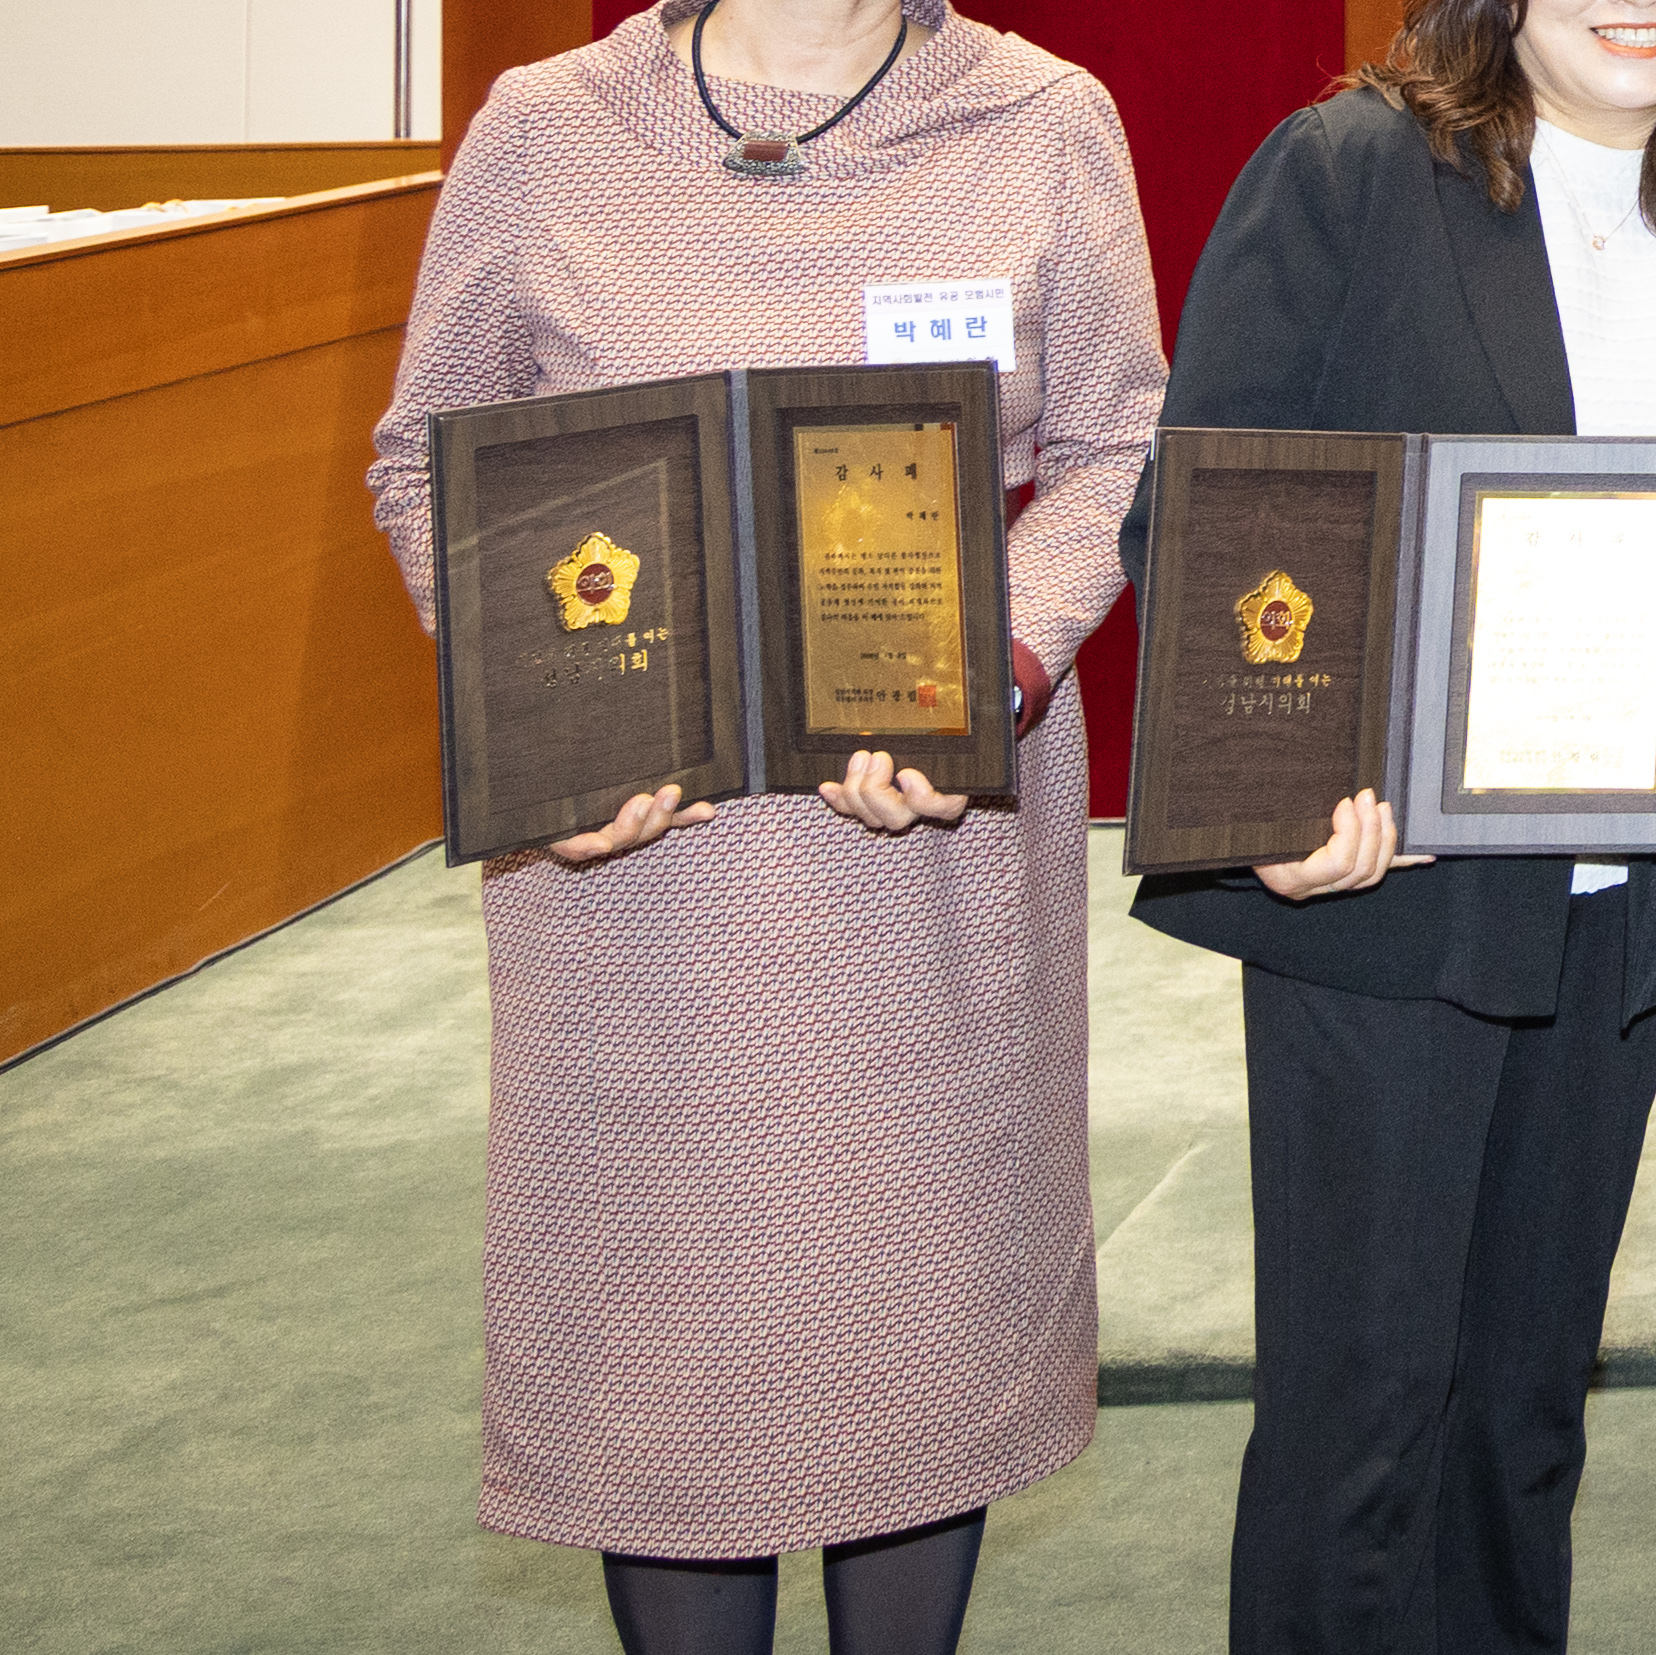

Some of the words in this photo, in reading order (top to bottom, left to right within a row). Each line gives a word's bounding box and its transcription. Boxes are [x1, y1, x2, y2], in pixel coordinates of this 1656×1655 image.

[872, 292, 933, 306] 지역사회발전
[939, 291, 959, 302] 유공
[964, 288, 1005, 301] 모범시민
